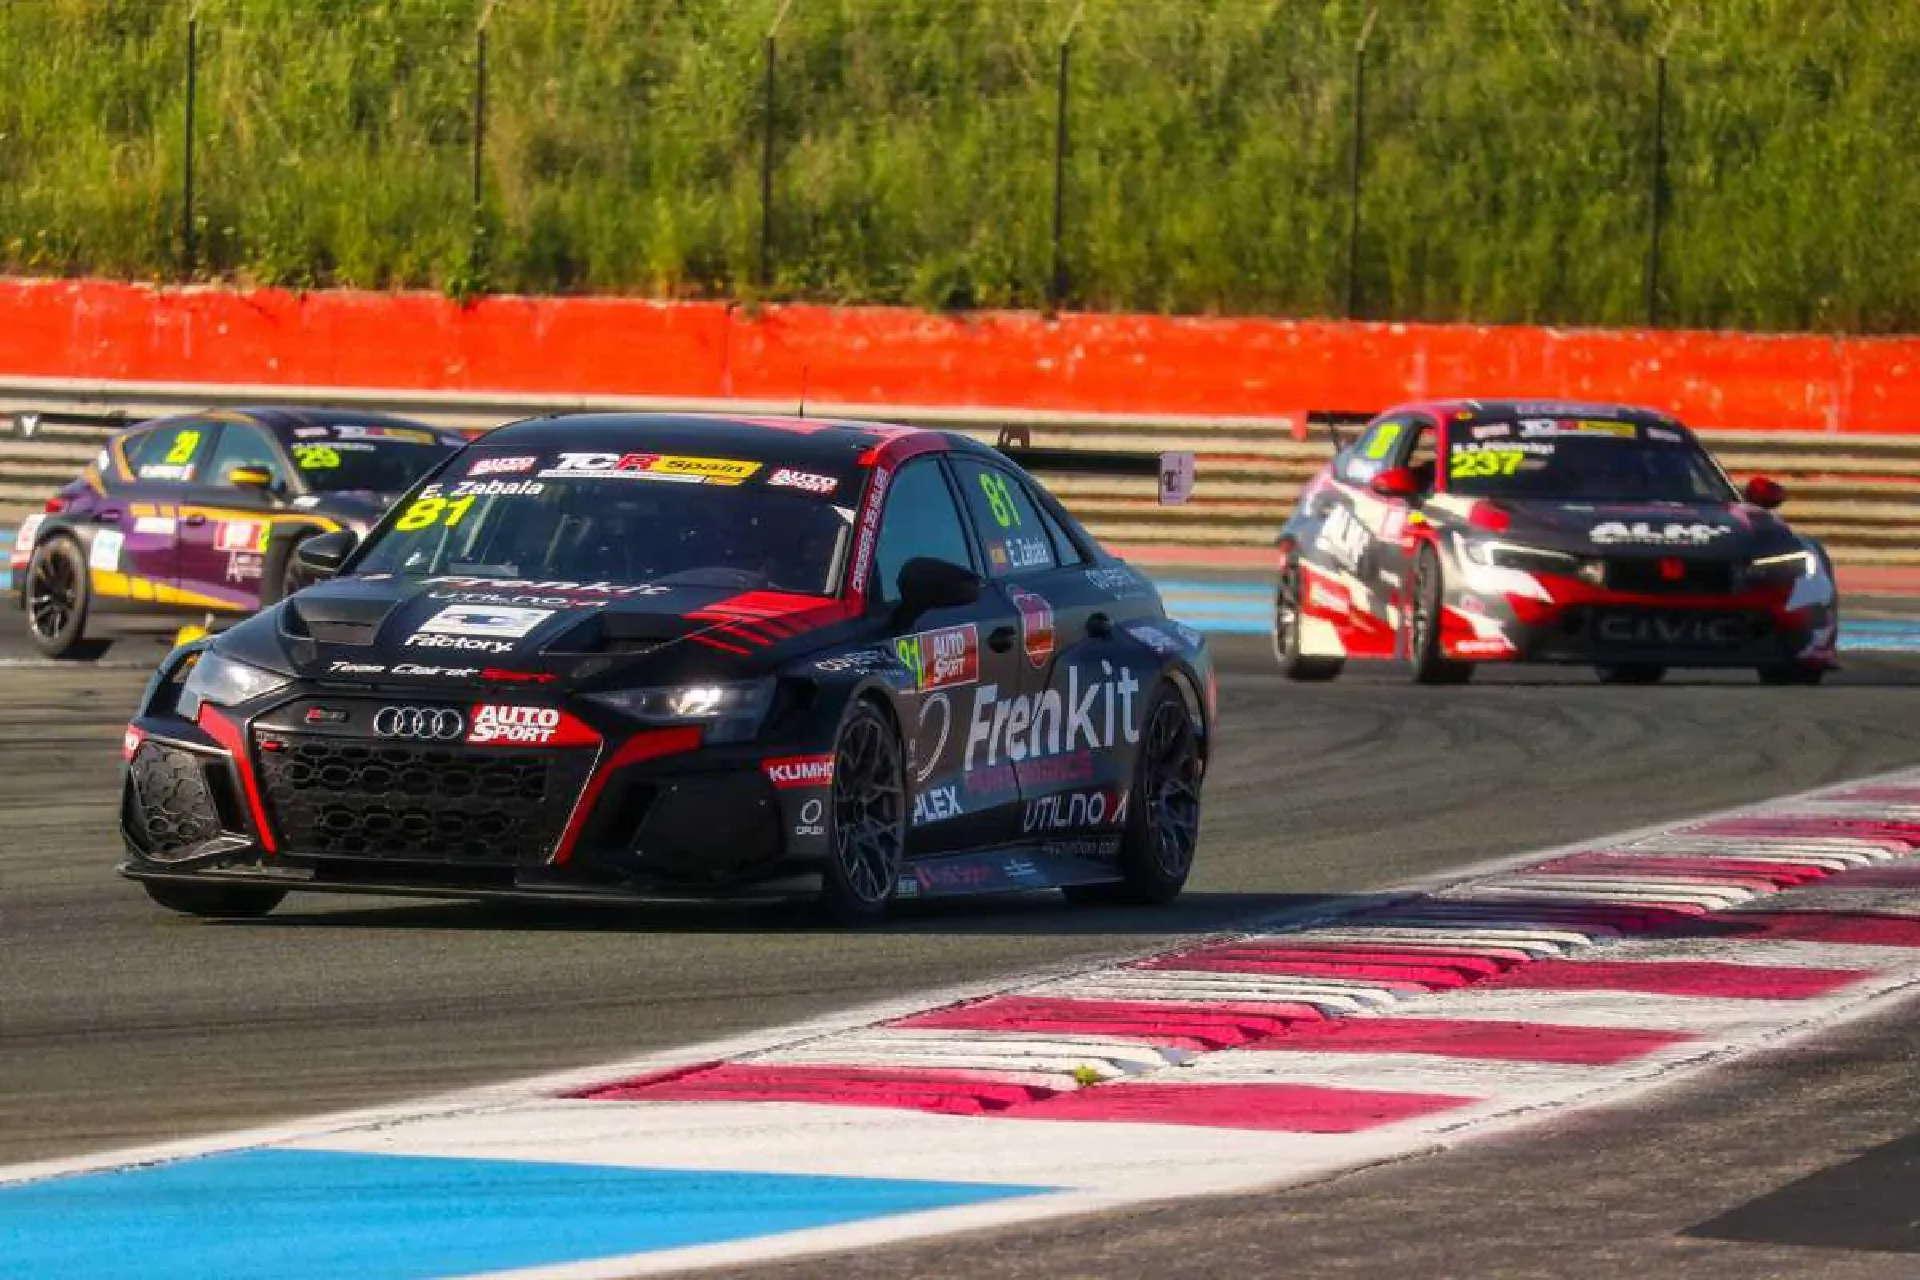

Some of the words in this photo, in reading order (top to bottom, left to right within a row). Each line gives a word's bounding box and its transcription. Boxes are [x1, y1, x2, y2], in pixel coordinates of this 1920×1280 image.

[554, 452, 662, 471] TCR
[665, 460, 745, 473] Spain
[1450, 450, 1524, 478] 237
[417, 482, 444, 499] E.
[450, 479, 545, 496] Zabala
[978, 471, 1022, 528] 81
[395, 493, 478, 531] 81
[1601, 616, 1740, 642] CIVIC
[933, 631, 966, 656] AUTO
[474, 704, 560, 726] AUTO
[964, 658, 1140, 772] Frenkit
[468, 724, 556, 743] SPORT
